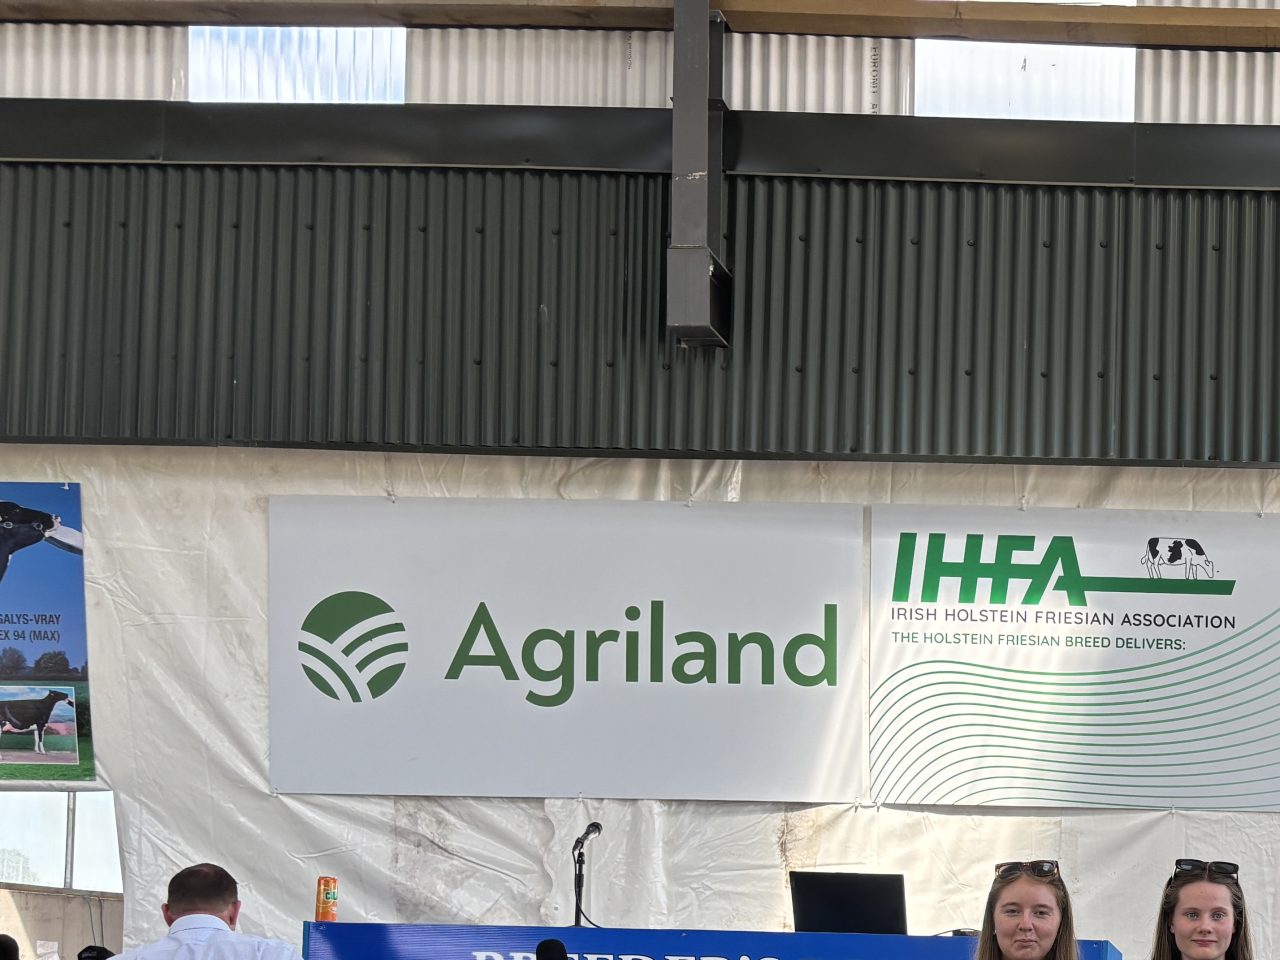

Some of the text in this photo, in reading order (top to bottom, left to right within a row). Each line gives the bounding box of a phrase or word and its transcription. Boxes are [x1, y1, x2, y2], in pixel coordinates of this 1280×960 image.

[892, 532, 1089, 606] IHFA
[891, 607, 1236, 629] IRISH HOLSTEIN FRIESIAN ASSOCIATION
[13, 630, 26, 640] 94
[29, 630, 60, 643] (MAX)
[891, 632, 1186, 650] THE HOLSTEIN FRIESIAN BREED DELIVERS:
[442, 600, 839, 708] Agriland
